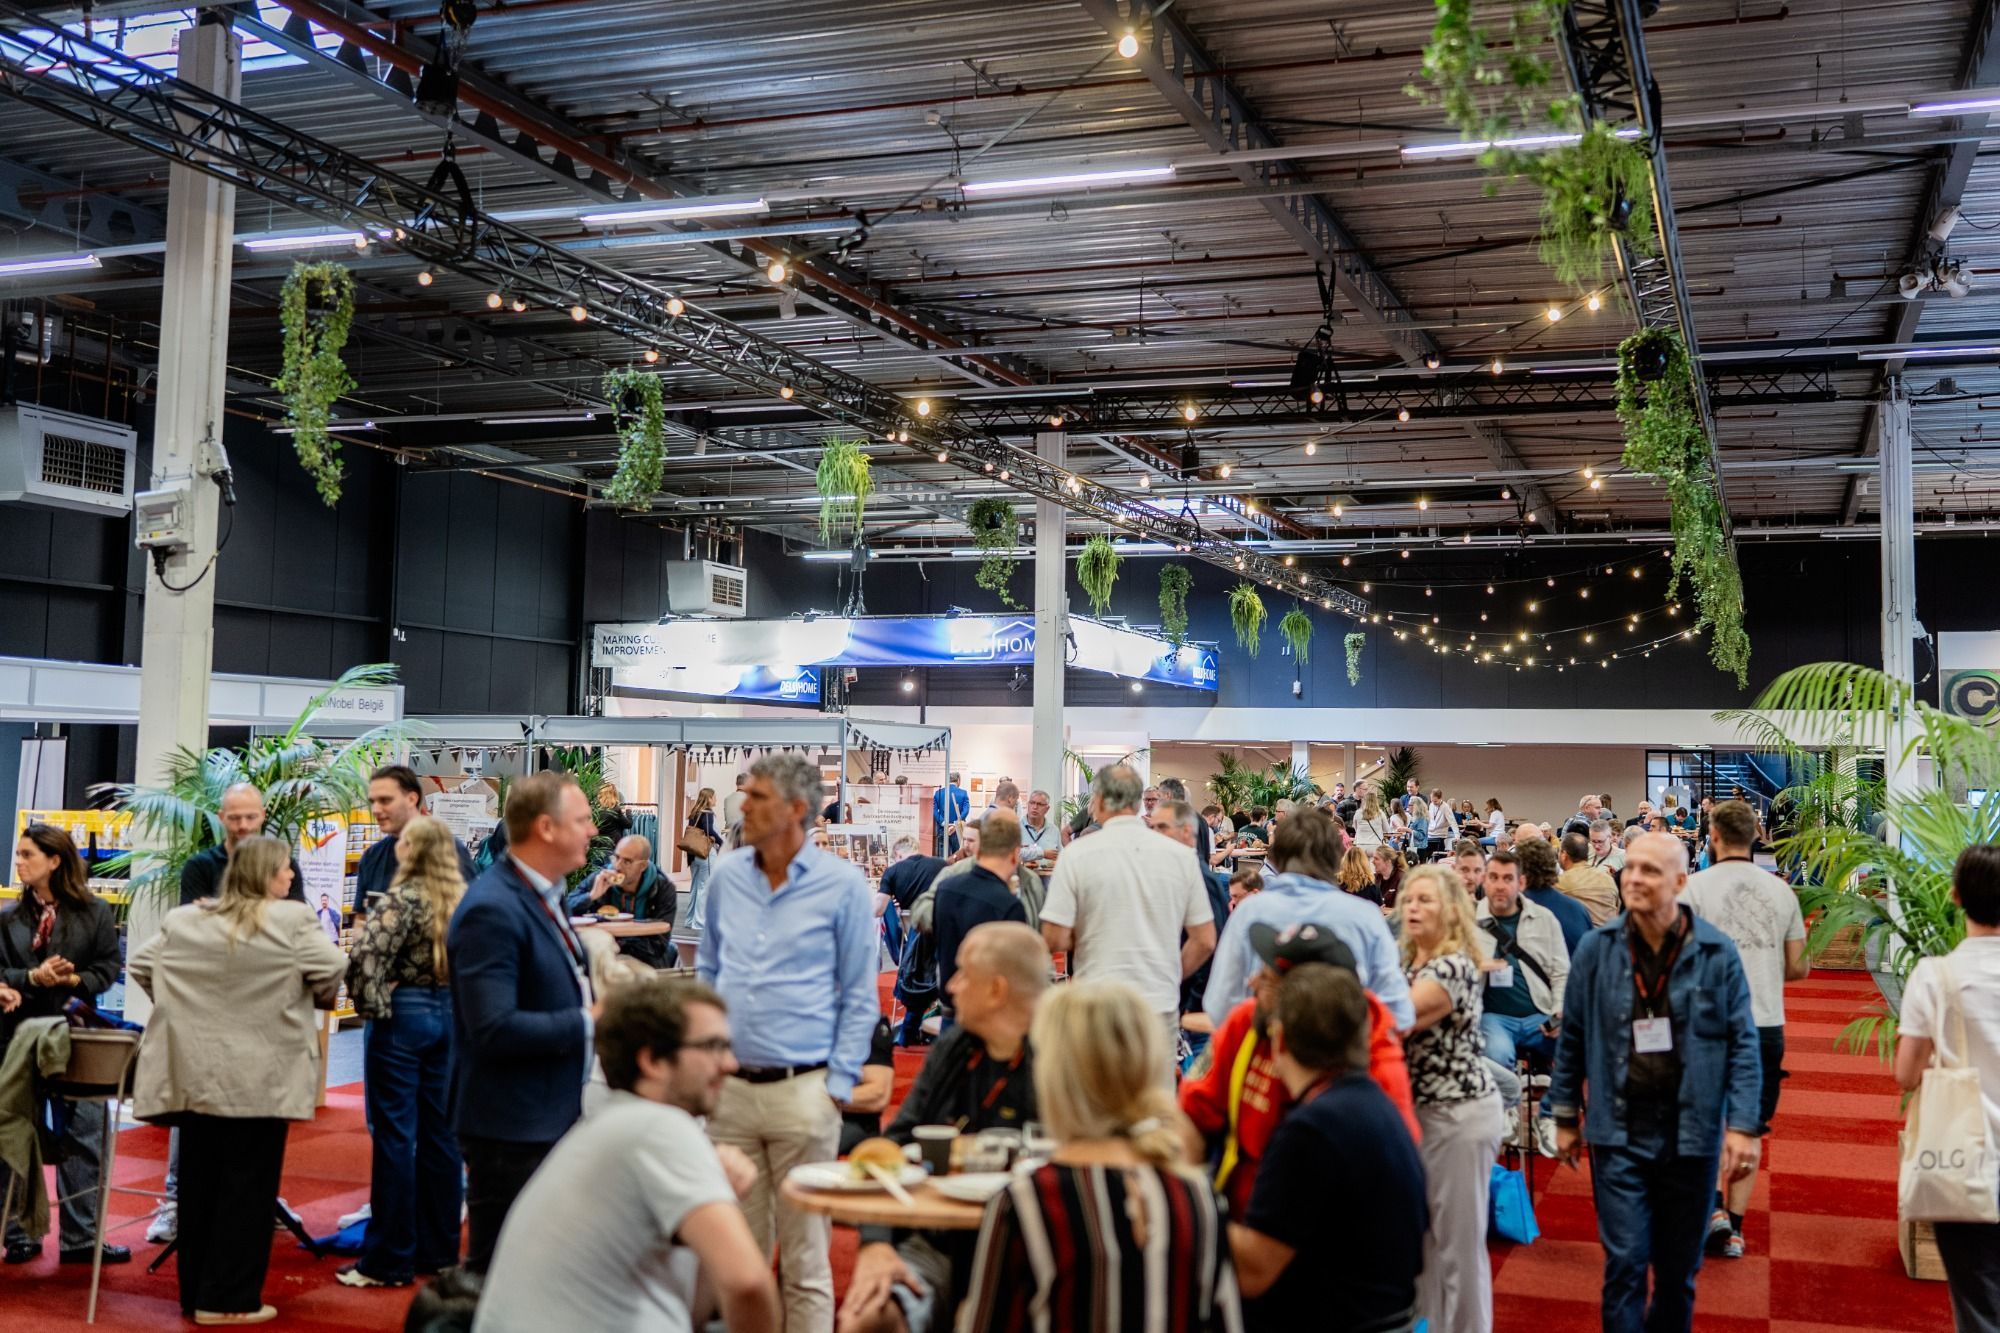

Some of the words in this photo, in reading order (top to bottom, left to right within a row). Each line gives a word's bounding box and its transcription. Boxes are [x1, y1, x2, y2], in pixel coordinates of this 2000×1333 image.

[602, 635, 641, 645] MAKING
[997, 637, 1036, 652] HOM
[308, 695, 355, 710] AoNobel
[358, 698, 385, 713] België
[1913, 1148, 1966, 1171] OLG
